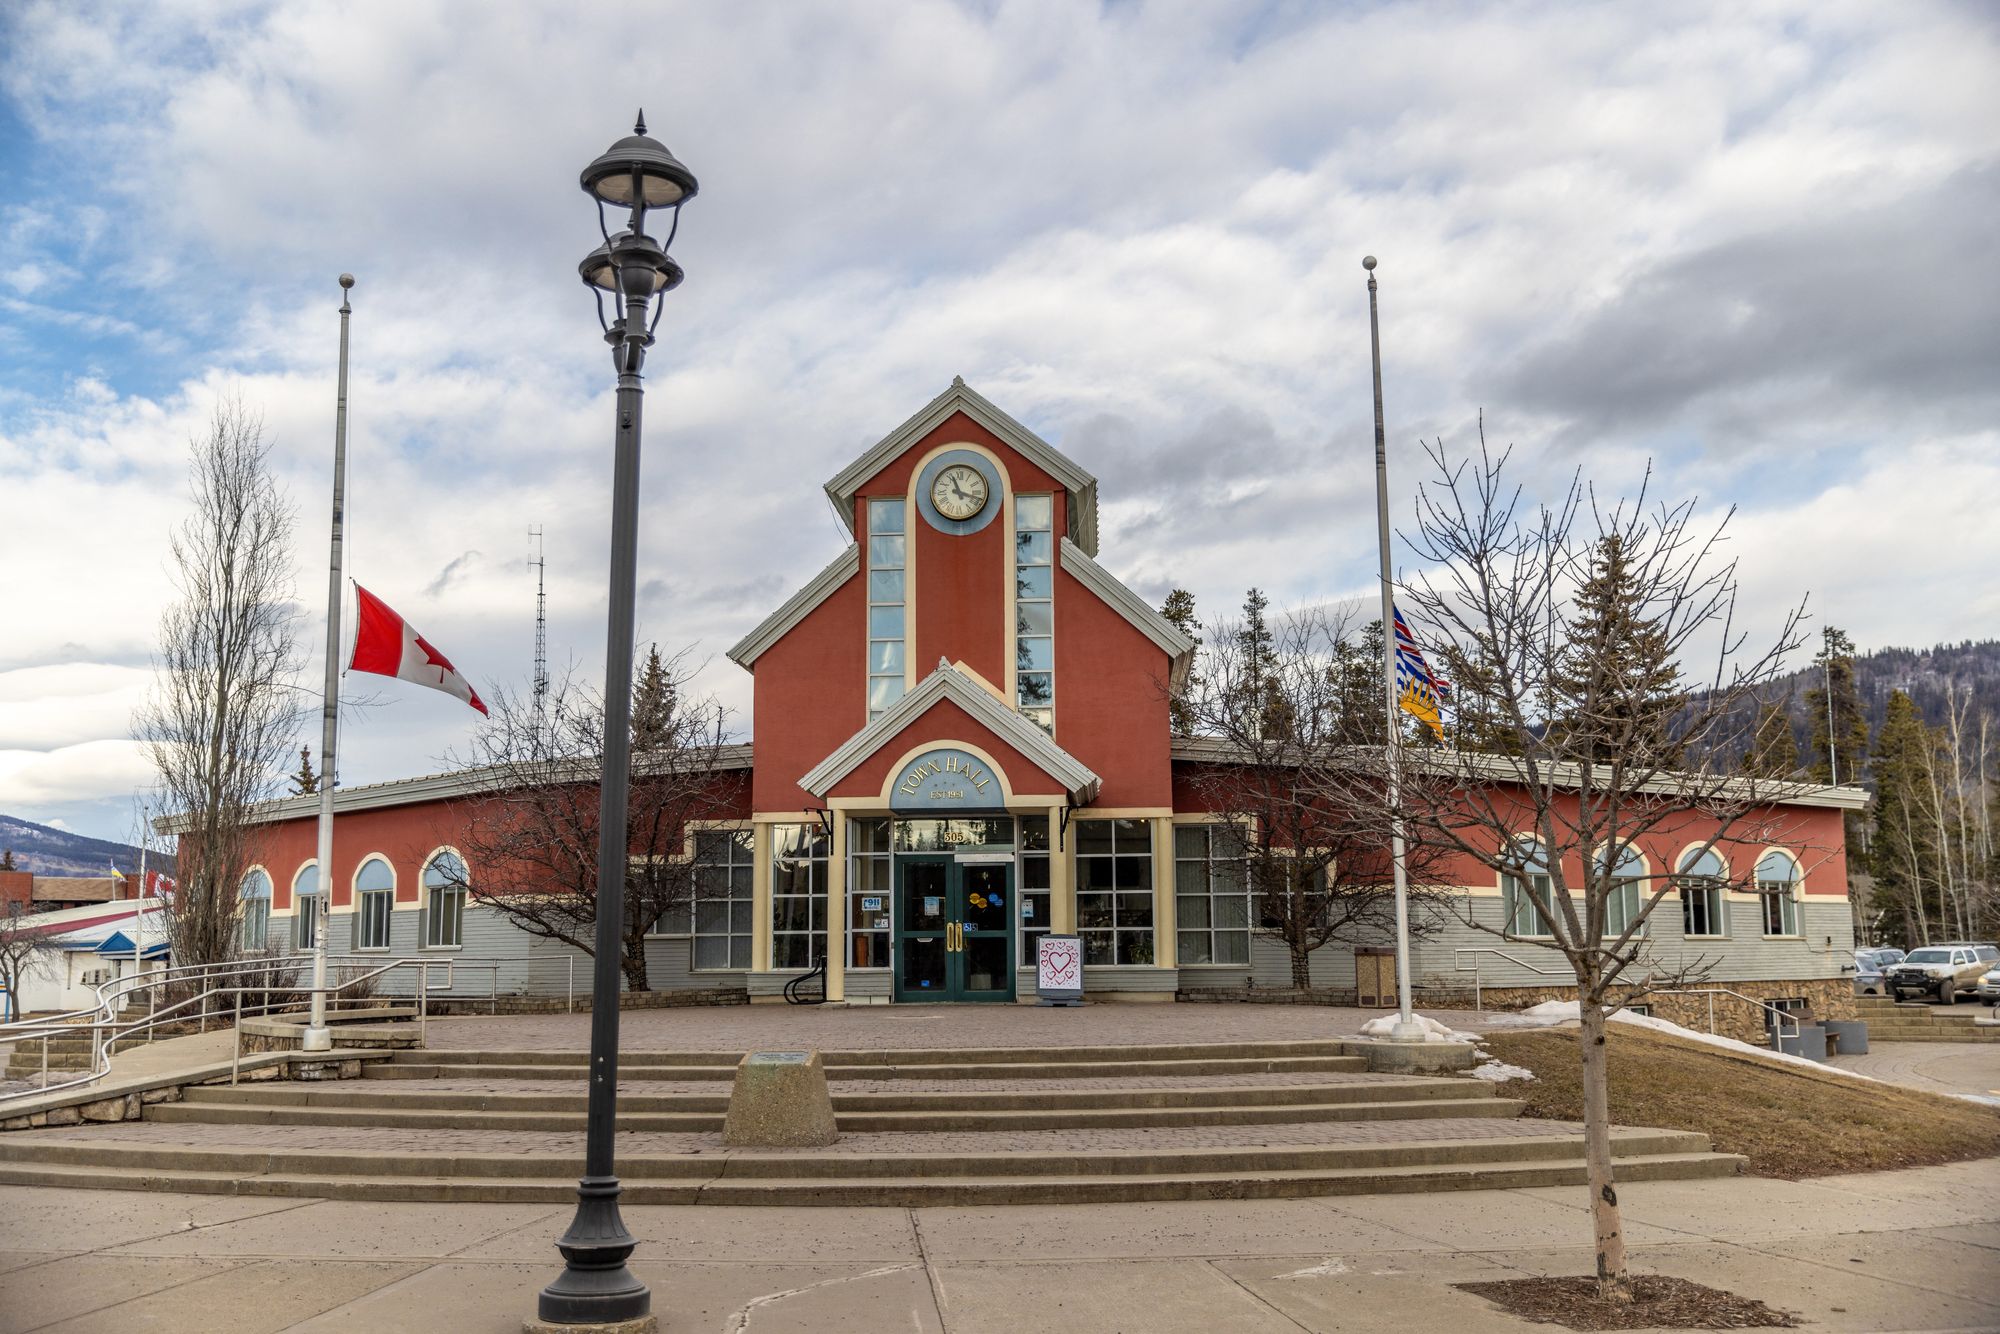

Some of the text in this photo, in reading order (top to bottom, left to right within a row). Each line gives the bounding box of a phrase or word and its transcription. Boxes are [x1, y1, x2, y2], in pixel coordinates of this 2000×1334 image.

[900, 757, 990, 796] TOWN HALL
[945, 832, 964, 842] 305
[867, 898, 880, 906] 911
